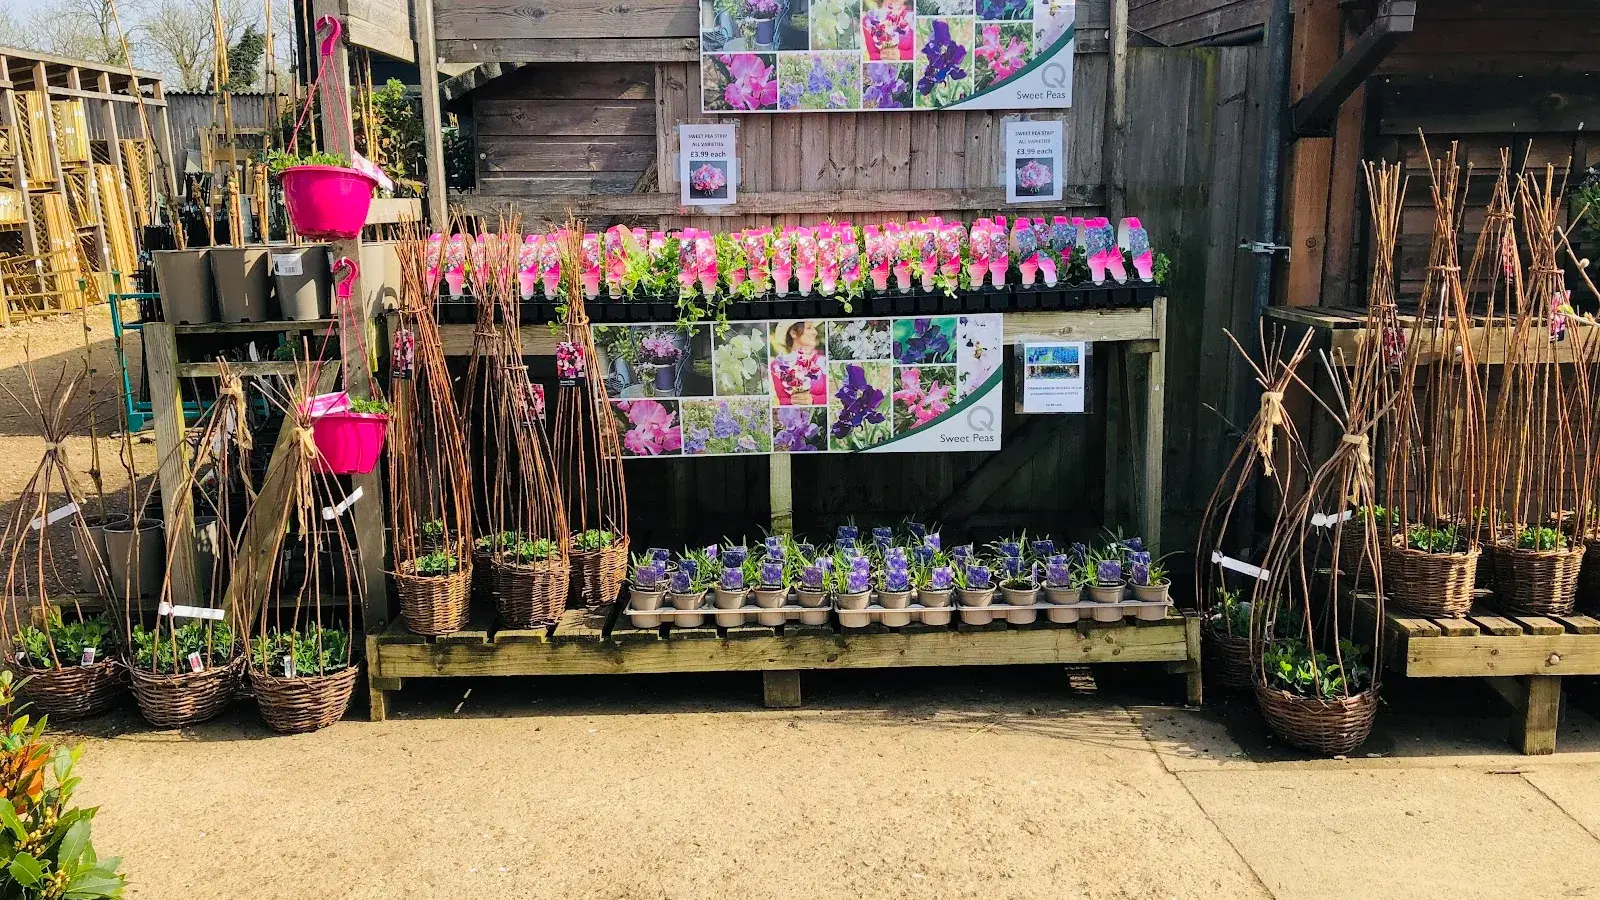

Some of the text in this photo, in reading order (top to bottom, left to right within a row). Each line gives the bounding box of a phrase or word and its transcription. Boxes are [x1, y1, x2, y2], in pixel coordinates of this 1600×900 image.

[1016, 90, 1066, 100] Sweet Peas
[940, 433, 995, 443] Sweet Peas
